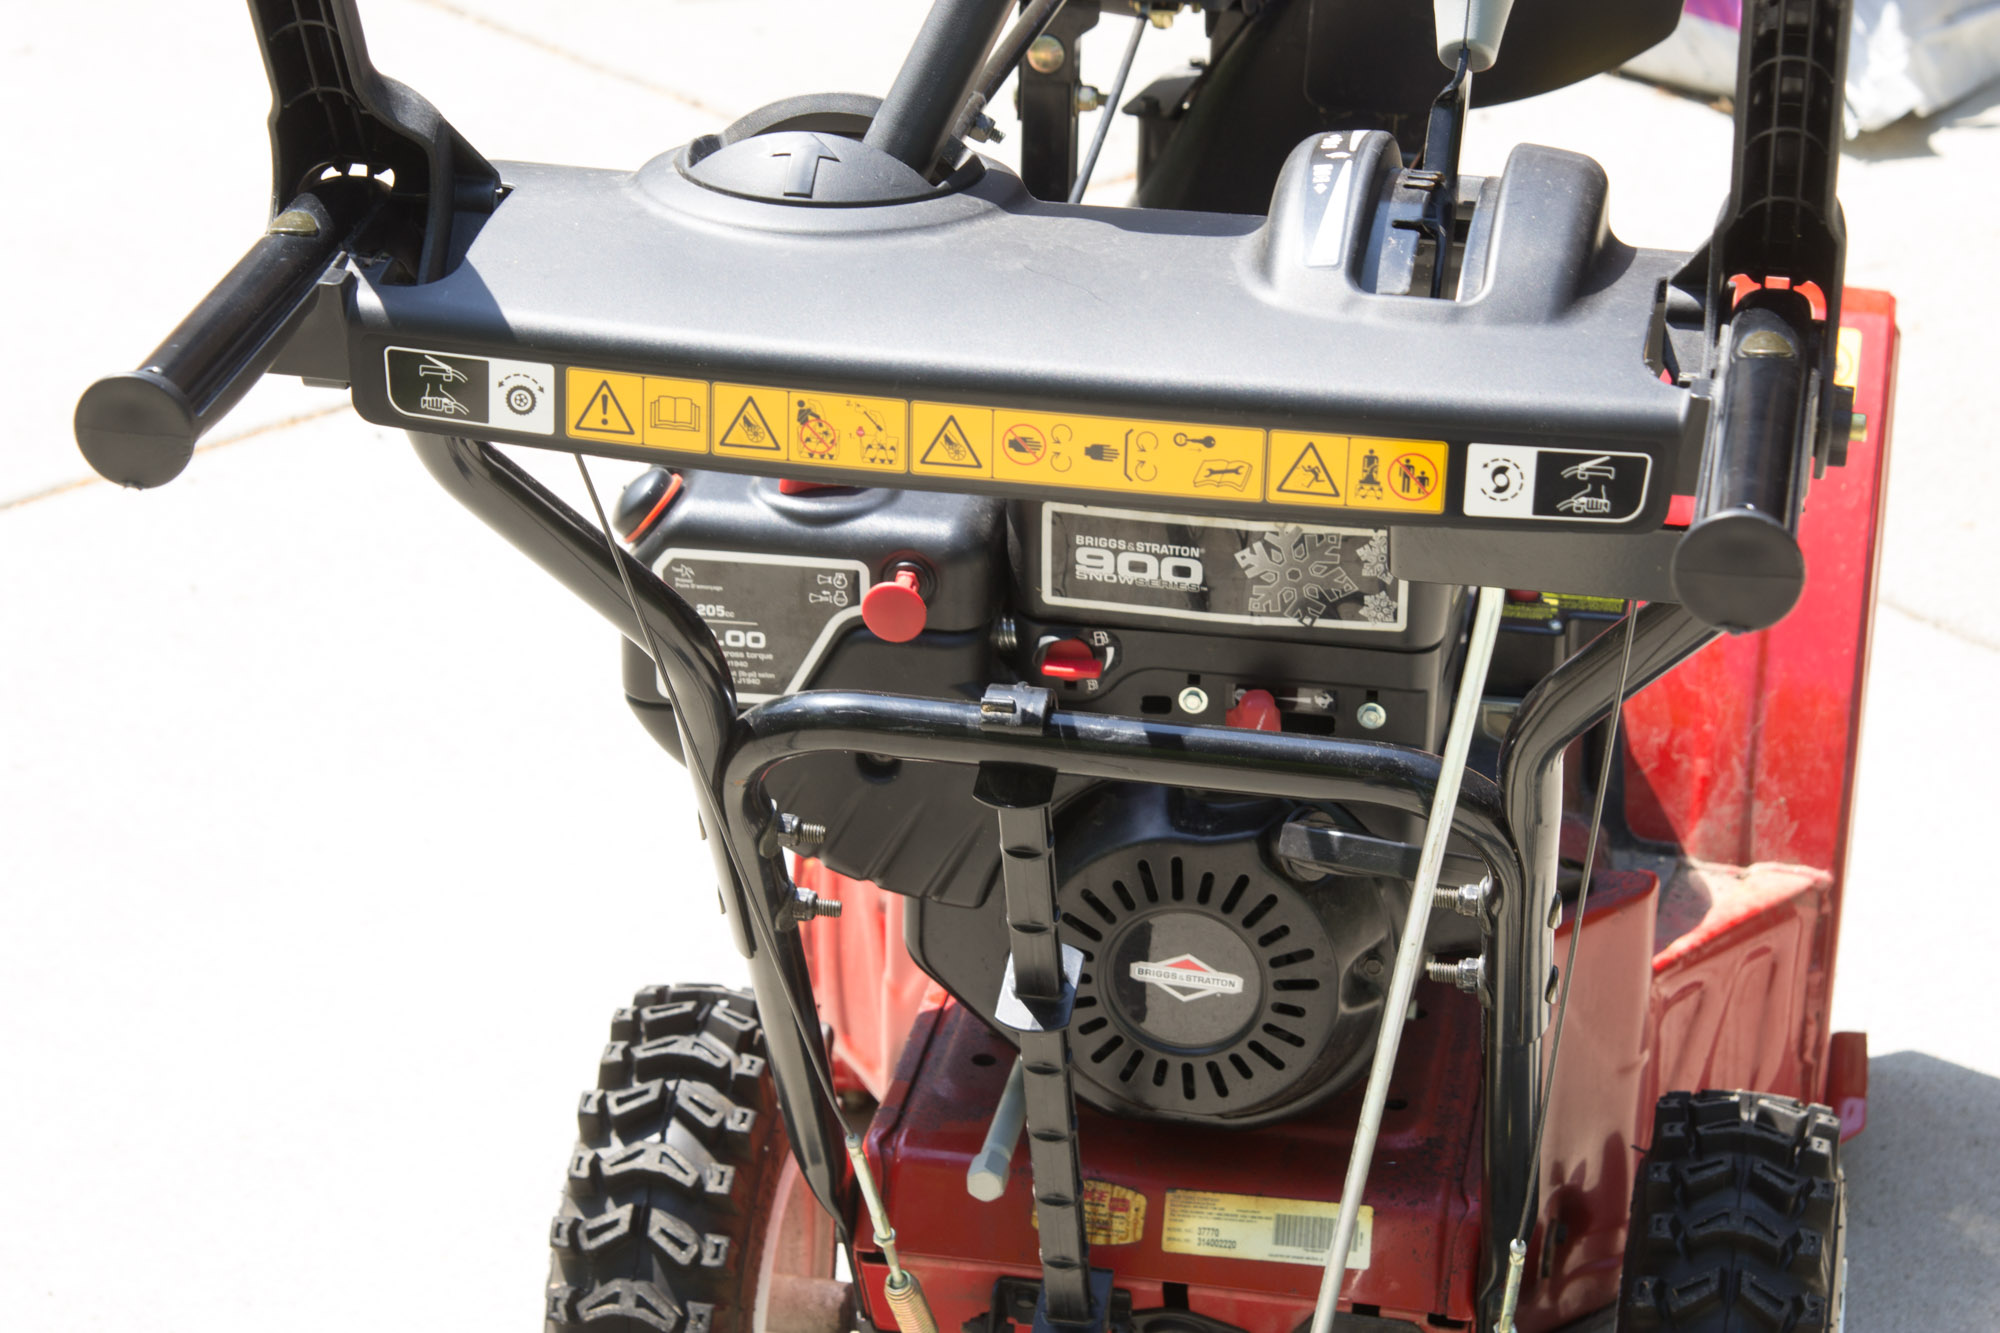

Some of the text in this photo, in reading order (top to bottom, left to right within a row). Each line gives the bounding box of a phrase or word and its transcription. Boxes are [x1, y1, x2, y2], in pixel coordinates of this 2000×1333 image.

[1075, 546, 1203, 583] 900
[711, 628, 766, 649] .00
[1197, 1226, 1220, 1238] 37770
